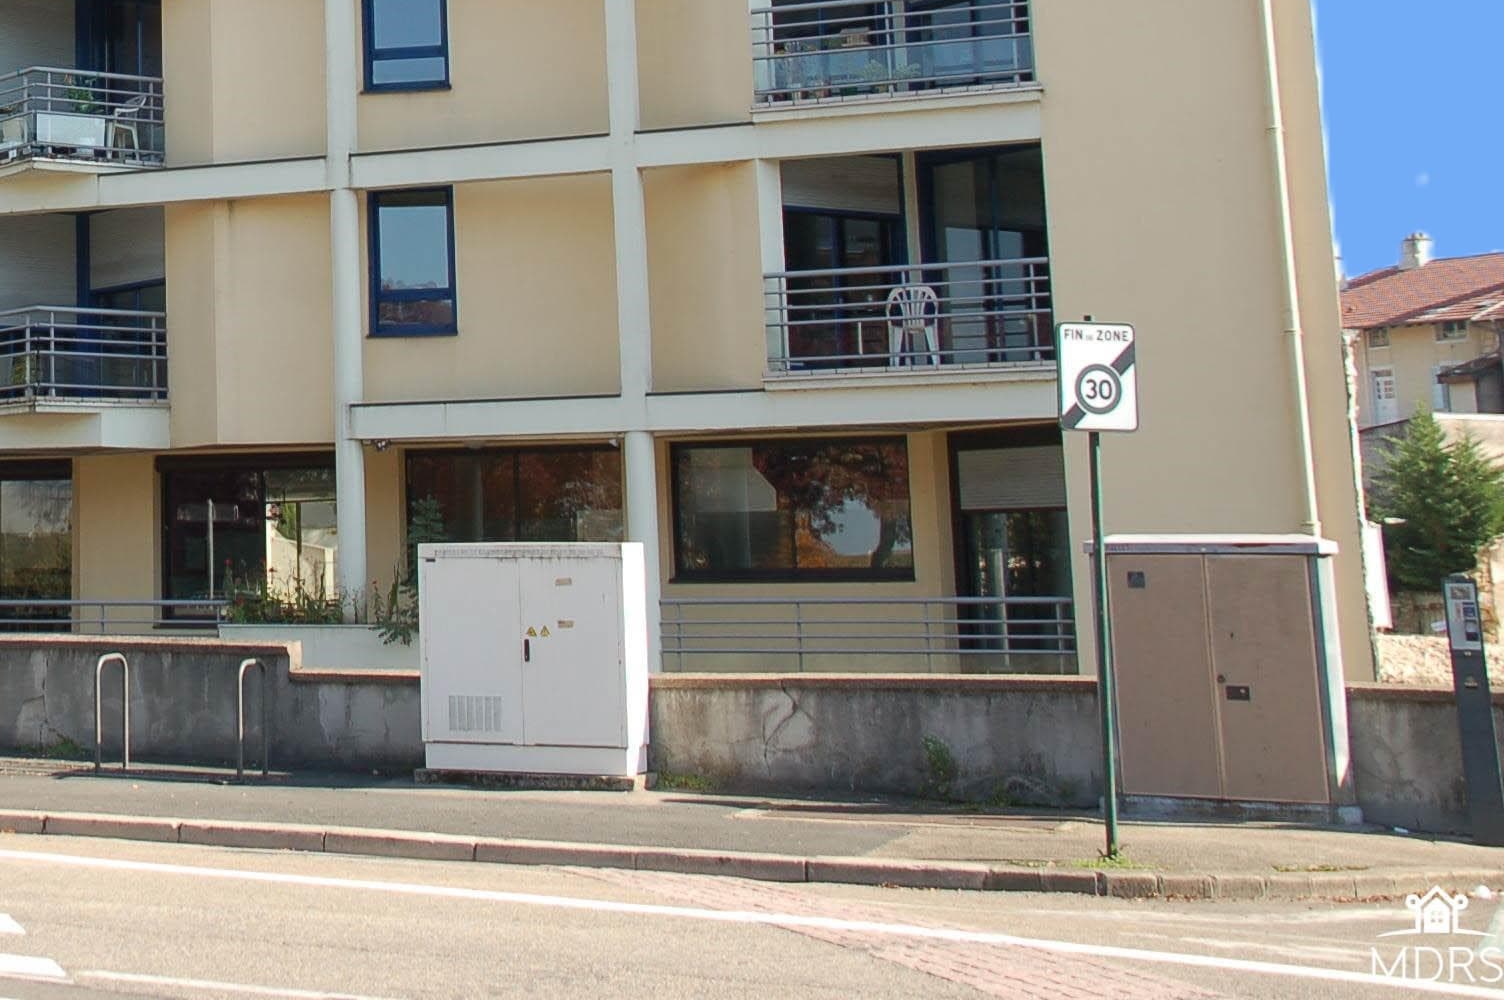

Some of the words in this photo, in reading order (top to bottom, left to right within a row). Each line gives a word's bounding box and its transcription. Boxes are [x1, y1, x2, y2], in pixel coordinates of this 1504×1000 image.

[1064, 328, 1083, 340] FIN
[1096, 329, 1129, 342] ZONE
[1086, 379, 1112, 400] 30
